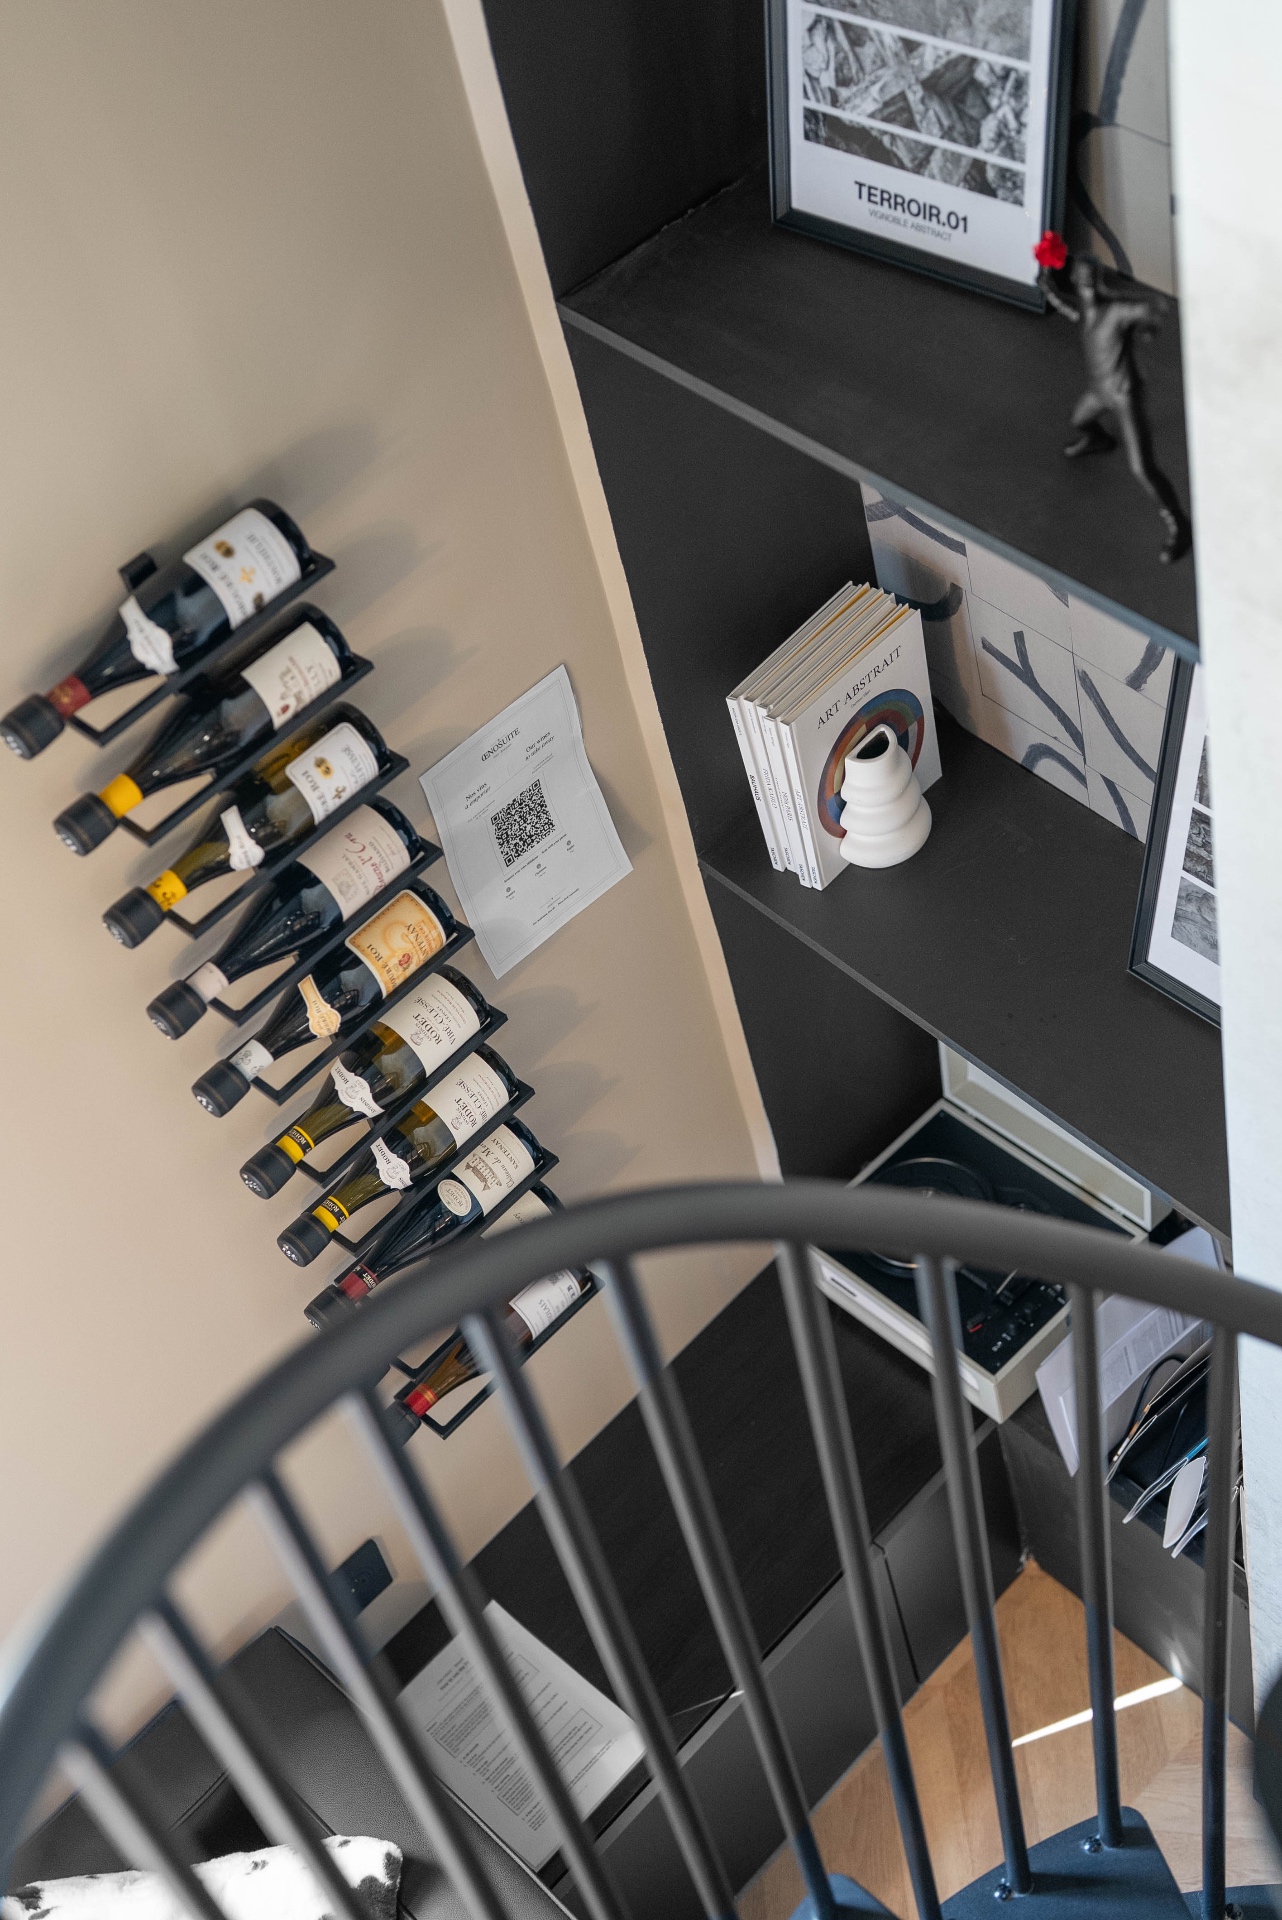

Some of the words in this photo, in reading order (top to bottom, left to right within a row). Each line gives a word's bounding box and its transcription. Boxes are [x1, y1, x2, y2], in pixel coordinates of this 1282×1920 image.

[854, 180, 968, 234] TERROIR.01
[868, 208, 909, 230] VIGNOBLE
[910, 221, 952, 242] ABSTRACT
[817, 702, 842, 729] ART
[844, 645, 902, 705] ABSTRAIT
[404, 922, 429, 961] ANTENAY
[412, 1011, 443, 1044] RODET
[413, 995, 456, 1045] VIRÉ-CLESSÉ
[454, 1096, 477, 1127] RODET
[375, 1143, 391, 1164] RODET
[490, 1137, 518, 1169] SANTENAY
[492, 1156, 501, 1164] de
[445, 1187, 463, 1206] RODET
